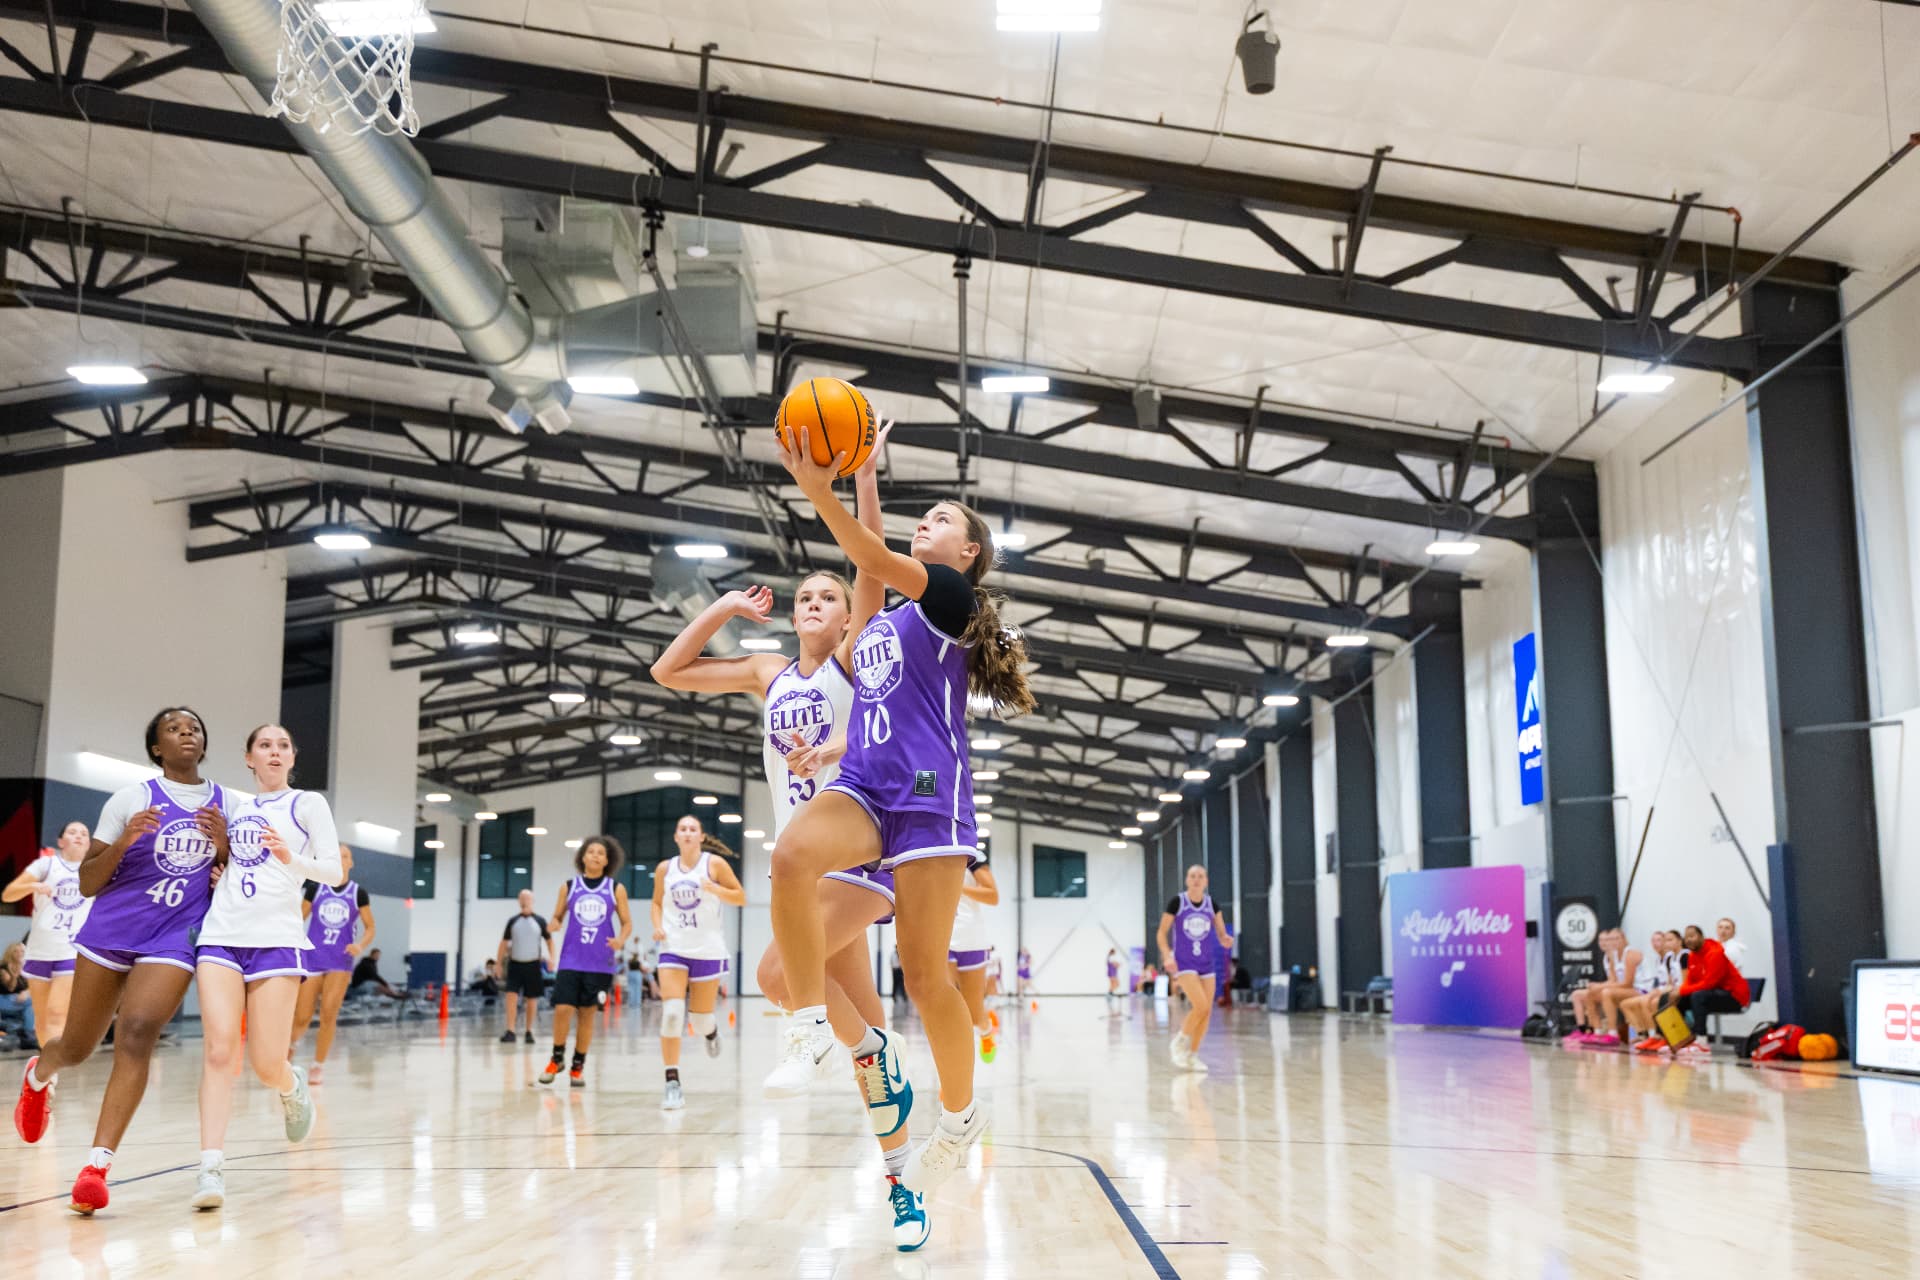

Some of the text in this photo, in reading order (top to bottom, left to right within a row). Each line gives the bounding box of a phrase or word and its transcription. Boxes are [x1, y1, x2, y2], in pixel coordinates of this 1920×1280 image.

[853, 639, 894, 674] ELITE
[770, 703, 824, 731] ELITE
[863, 703, 892, 749] 10
[164, 837, 214, 855] ELITE
[145, 877, 189, 907] 46
[241, 872, 256, 898] 6
[53, 912, 73, 930] 24
[679, 911, 698, 929] 34
[1400, 906, 1513, 944] Lady Notes
[1567, 919, 1587, 934] 50
[323, 928, 341, 945] 27
[580, 926, 598, 945] 57
[1411, 943, 1502, 957] BASKETBALL
